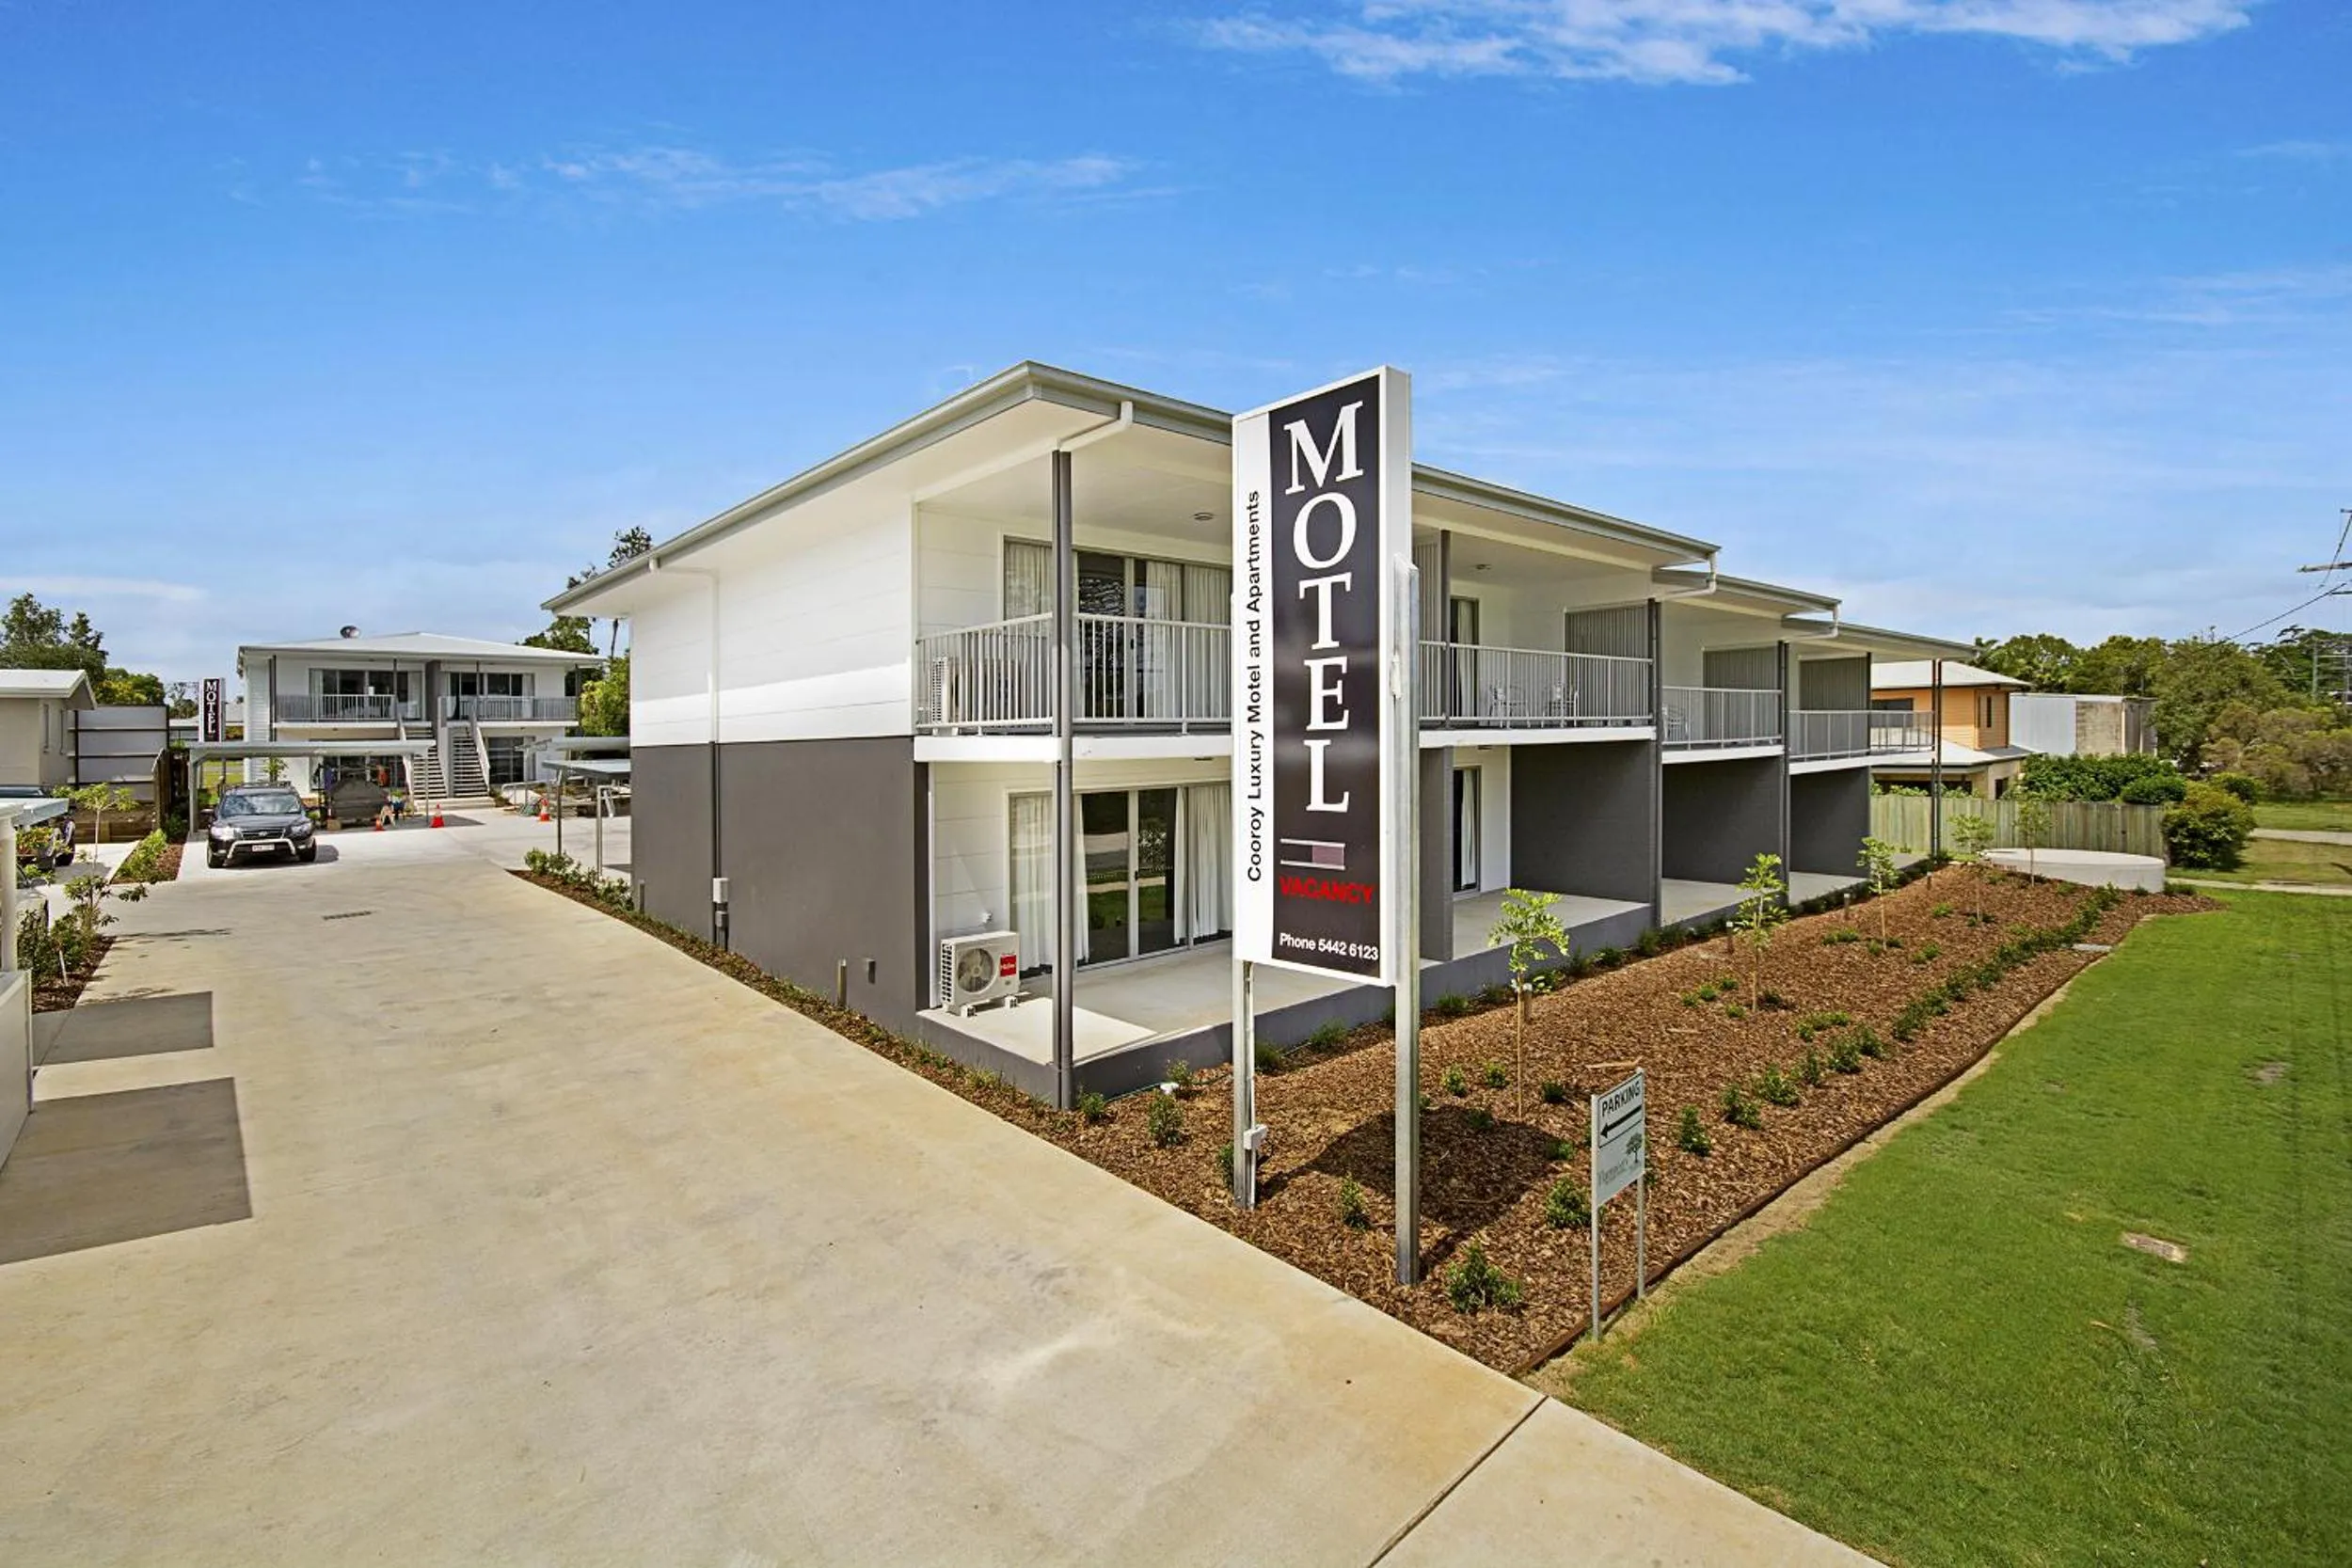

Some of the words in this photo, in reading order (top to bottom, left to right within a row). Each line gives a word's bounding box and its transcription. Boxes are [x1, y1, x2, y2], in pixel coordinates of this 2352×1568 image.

[1247, 490, 1262, 613] Apartments
[1283, 401, 1364, 814] MOTEL
[1247, 619, 1260, 657] and
[206, 681, 217, 734] MOTEL
[1248, 664, 1261, 723] Motel
[1248, 730, 1263, 800] Luxury
[1248, 806, 1263, 882] Cooroy
[1279, 876, 1375, 905] VACANCY
[1279, 932, 1316, 951] Phone
[1318, 938, 1348, 957] 5442
[1348, 942, 1379, 961] 6123
[1601, 1080, 1642, 1117] PARKING
